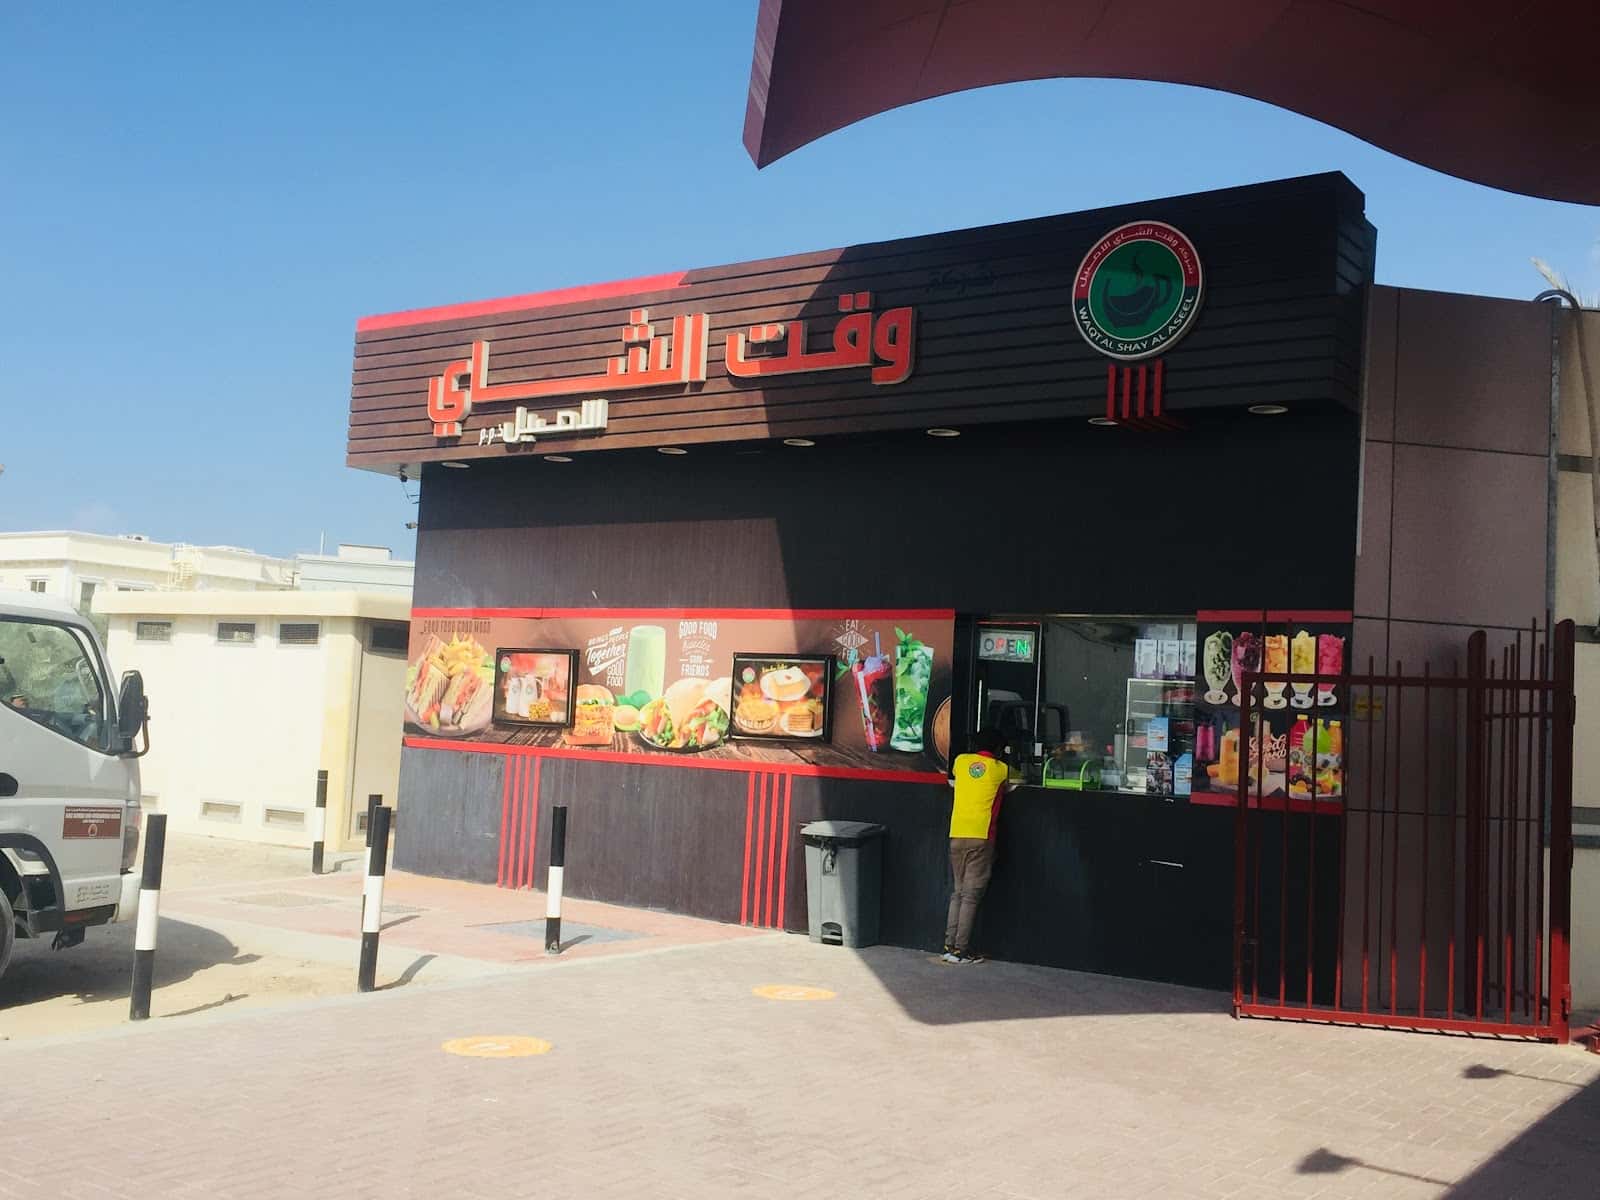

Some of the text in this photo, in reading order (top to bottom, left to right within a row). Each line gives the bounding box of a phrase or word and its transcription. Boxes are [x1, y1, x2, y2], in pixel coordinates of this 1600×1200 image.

[1079, 295, 1195, 352] WAQT AL SHAY AL ASEEL
[427, 291, 914, 438] وقت الشاي
[679, 621, 718, 640] GOOD FOOD
[845, 619, 859, 631] EAT
[585, 643, 627, 665] Together
[984, 638, 1029, 657] OPEN
[607, 659, 625, 675] GOOD
[606, 676, 624, 687] FOOD
